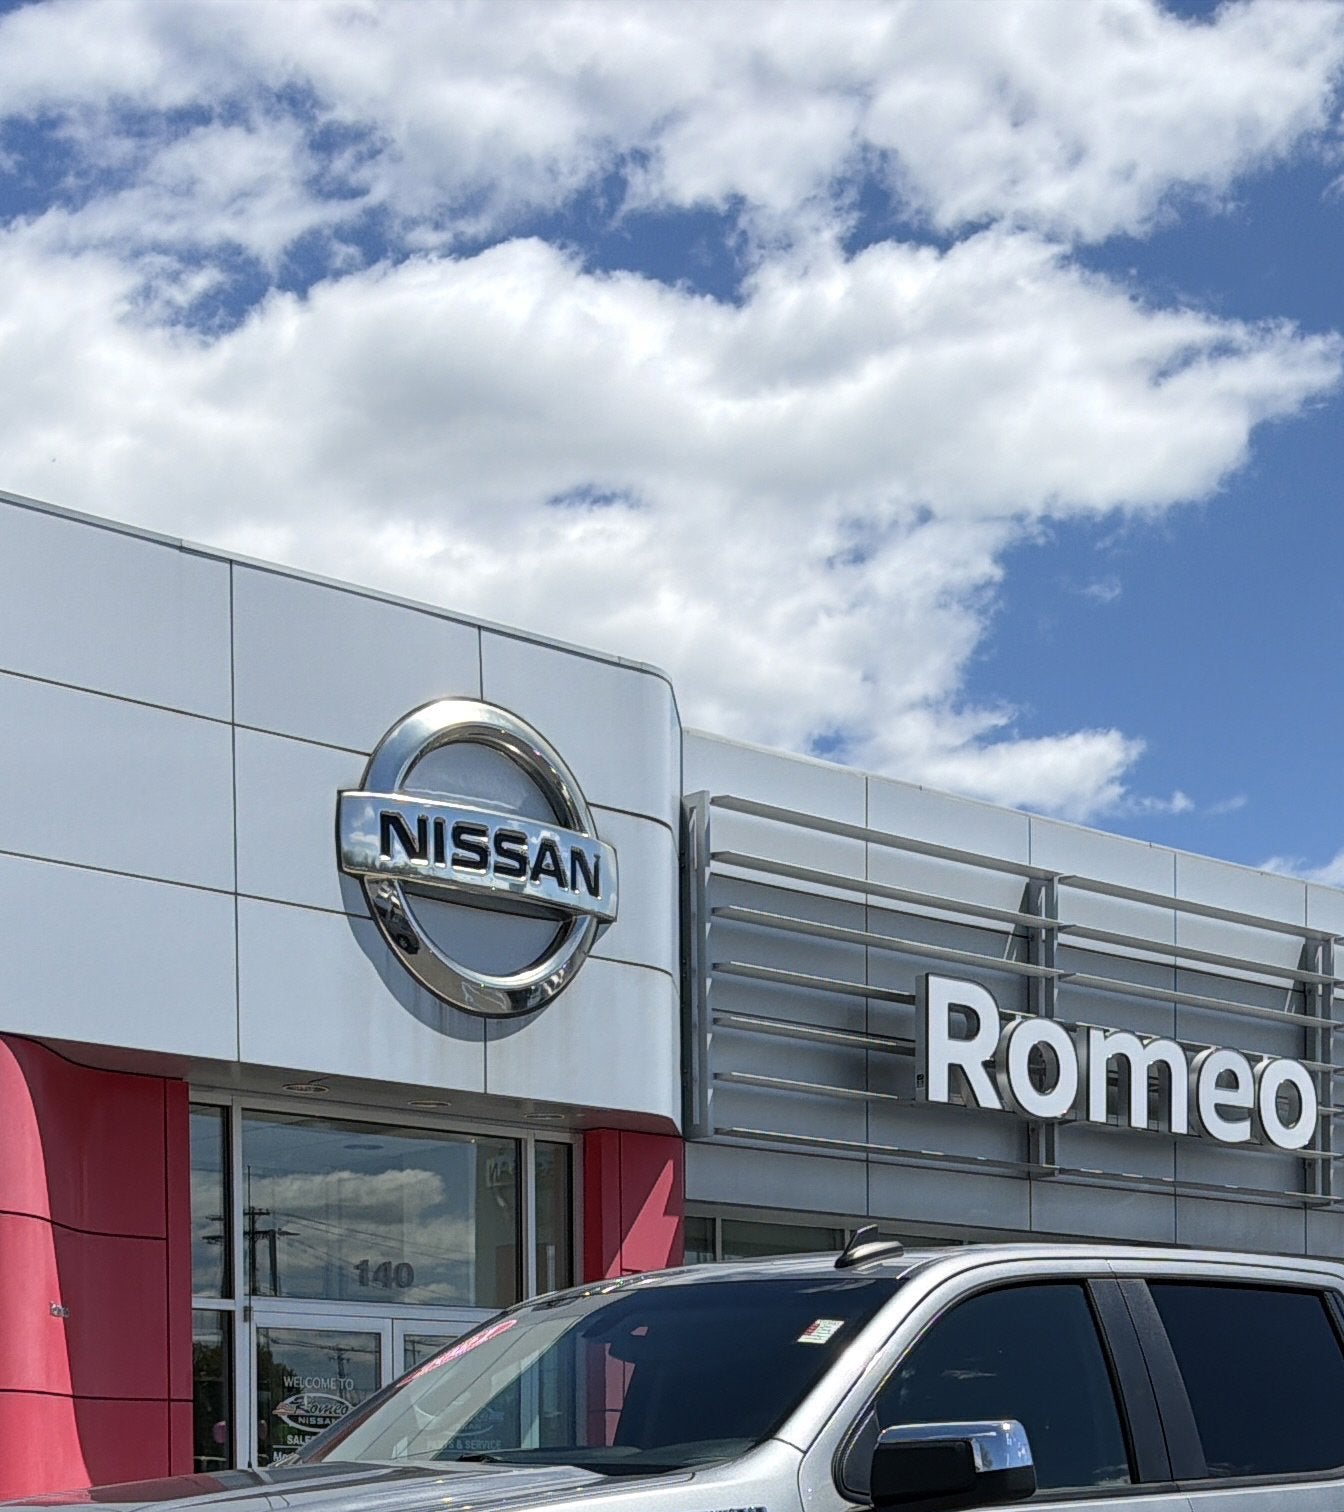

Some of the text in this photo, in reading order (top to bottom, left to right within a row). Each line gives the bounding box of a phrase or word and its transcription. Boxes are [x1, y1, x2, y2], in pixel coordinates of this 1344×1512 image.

[379, 810, 602, 899] NISSAN
[924, 973, 1318, 1150] Romeo
[353, 1259, 414, 1288] 140
[283, 1375, 355, 1390] WELCOME TO
[286, 1434, 316, 1445] SALE
[465, 1440, 502, 1450] SERVICE
